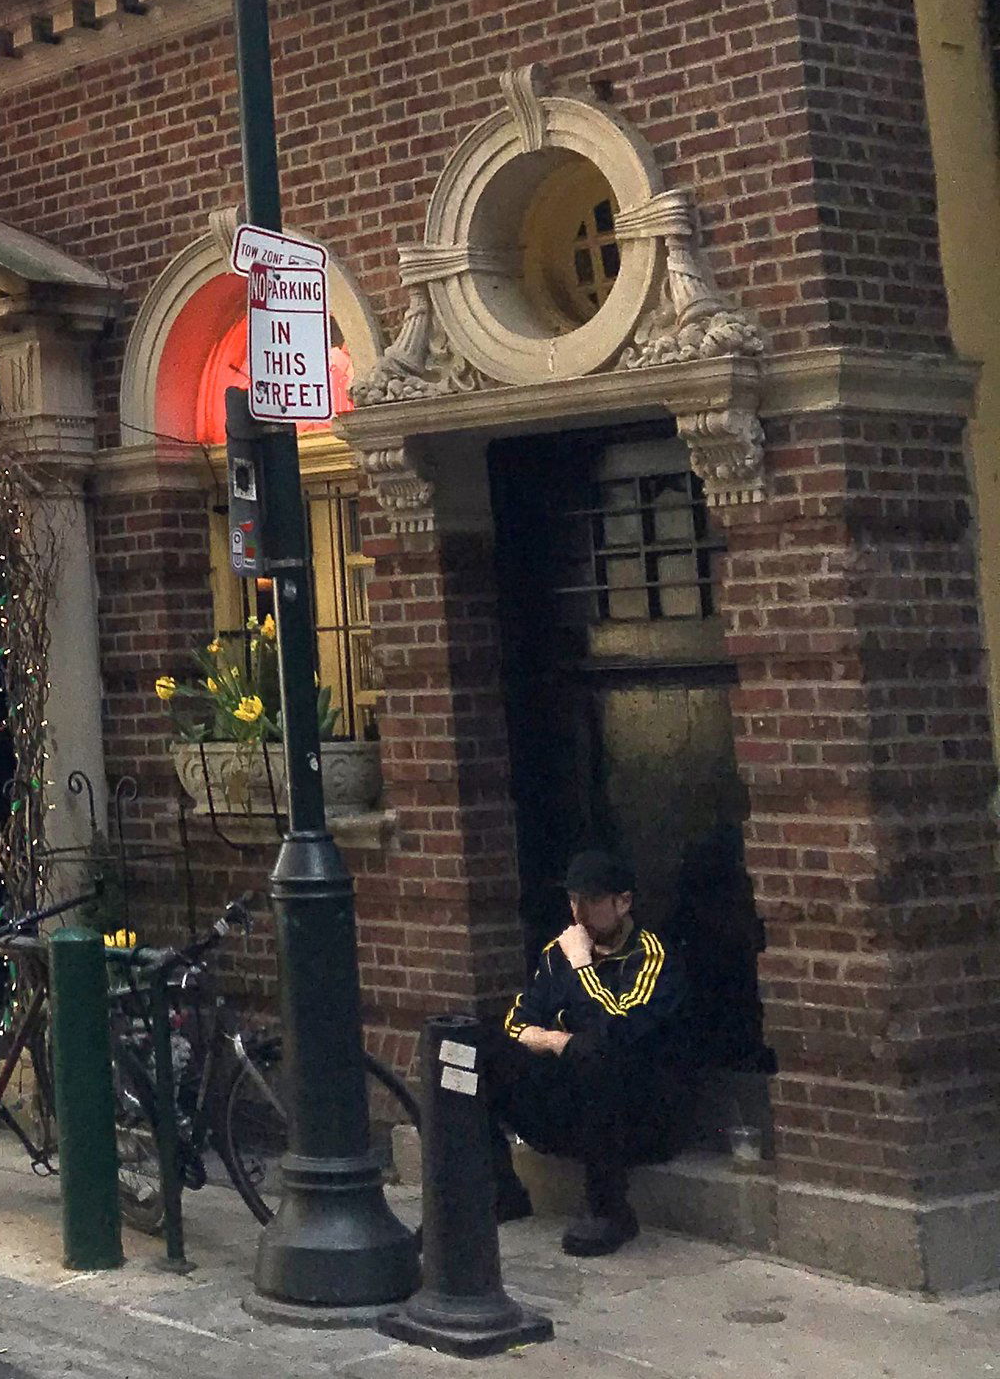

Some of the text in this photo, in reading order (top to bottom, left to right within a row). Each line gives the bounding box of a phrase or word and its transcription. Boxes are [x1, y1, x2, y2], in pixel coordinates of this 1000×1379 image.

[241, 243, 259, 259] TOW
[250, 271, 321, 302] NO PARKING
[271, 320, 291, 345] IN
[263, 350, 306, 376] THIS
[255, 380, 324, 407] STREET
